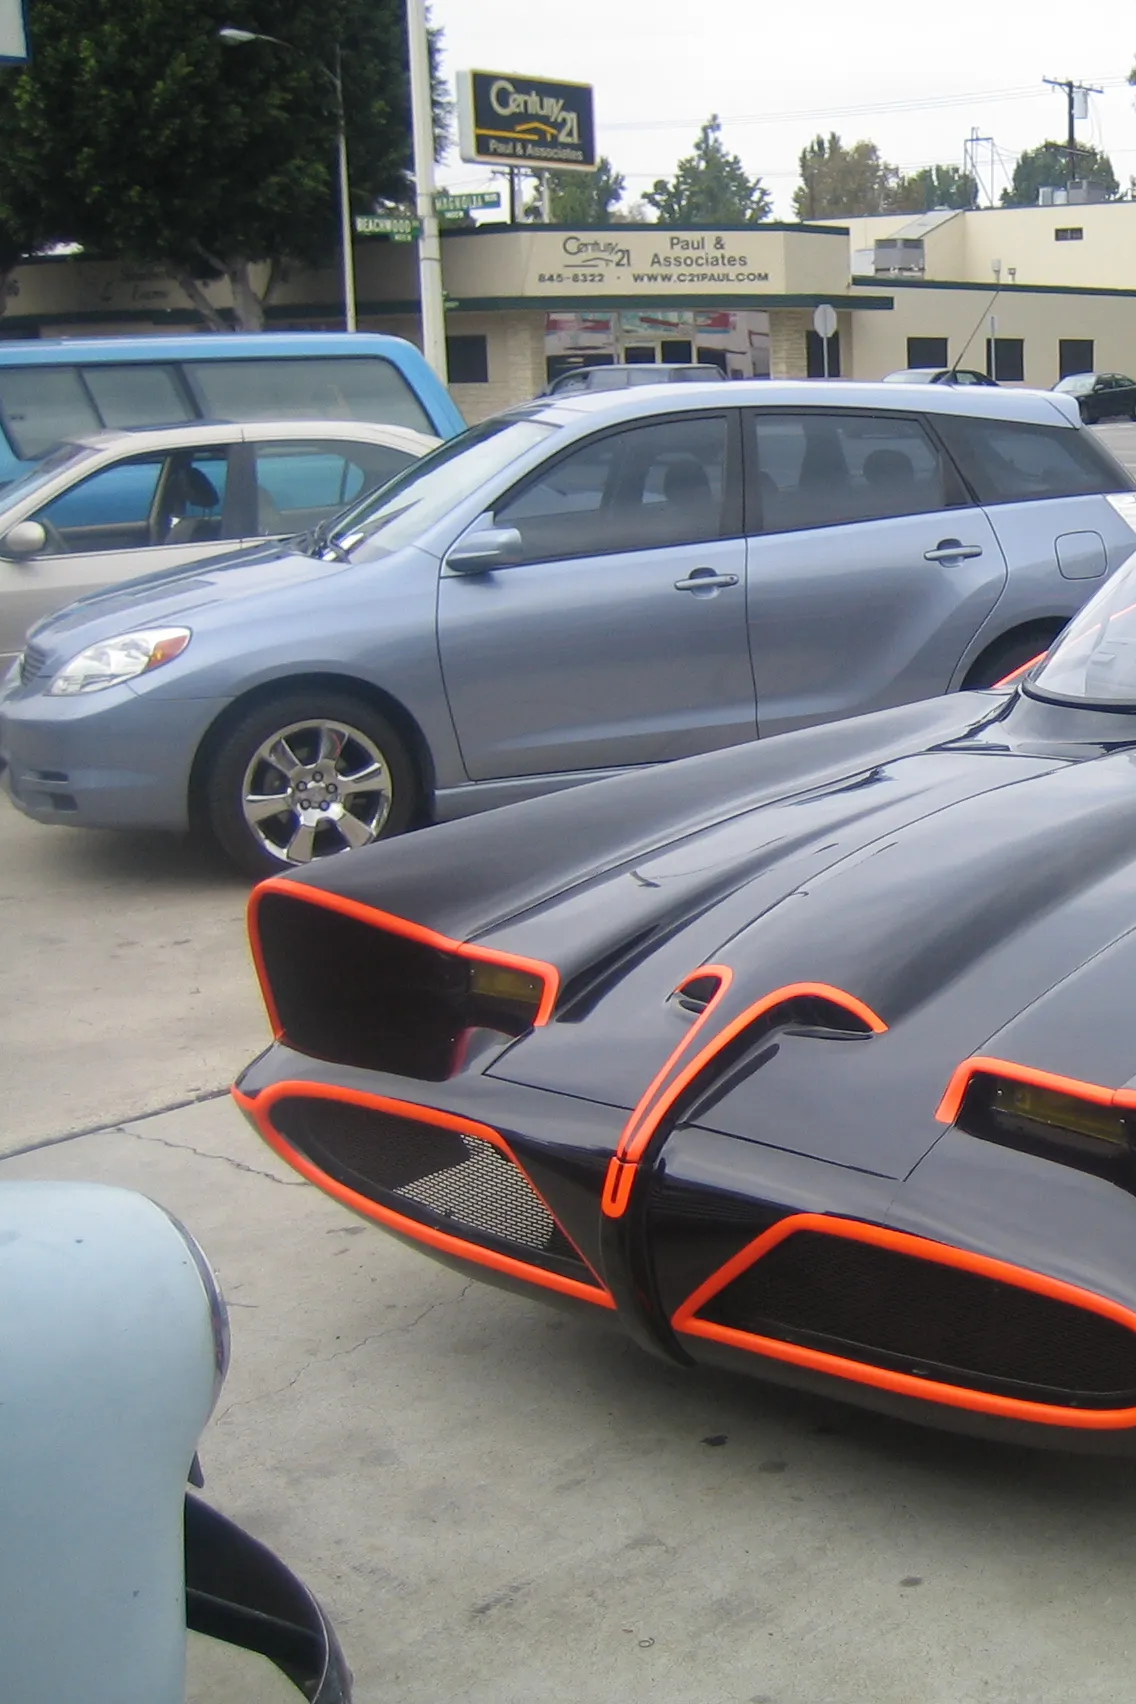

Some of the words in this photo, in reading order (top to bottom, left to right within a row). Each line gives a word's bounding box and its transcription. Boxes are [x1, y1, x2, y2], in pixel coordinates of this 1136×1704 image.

[489, 80, 565, 122] Century
[556, 110, 580, 143] 21
[488, 139, 513, 154] Paul
[526, 143, 583, 161] Associates
[563, 236, 619, 256] Century
[615, 248, 632, 267] 21
[669, 236, 705, 250] Paul
[713, 236, 725, 250] &
[650, 252, 748, 268] Associates
[538, 273, 605, 283] 845-8322
[632, 272, 769, 283] WWW.C21PAUL.COM
